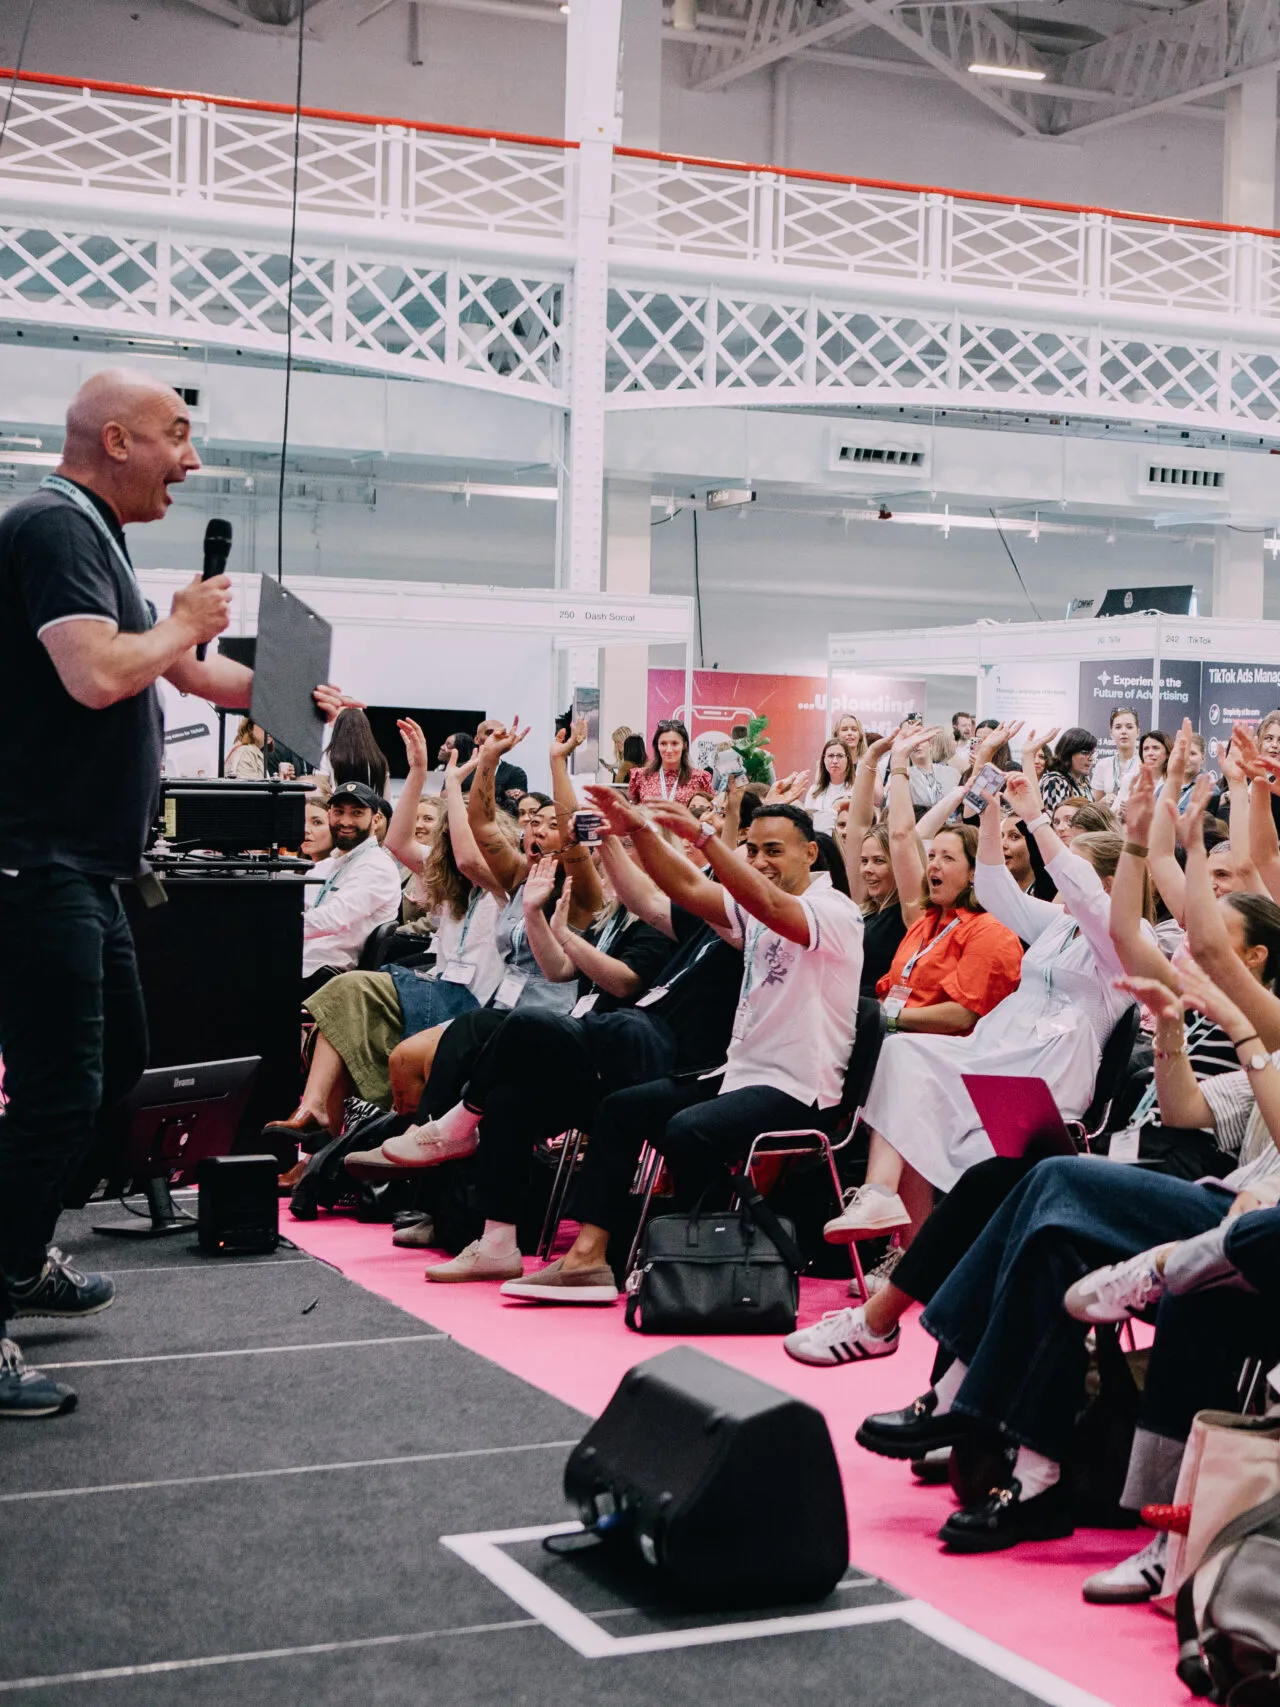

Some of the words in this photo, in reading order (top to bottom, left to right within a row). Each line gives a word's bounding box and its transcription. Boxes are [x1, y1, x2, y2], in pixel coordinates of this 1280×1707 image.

[559, 610, 575, 619] 250
[585, 611, 607, 621] Dash
[609, 612, 636, 622] Social
[1165, 634, 1180, 643] 242
[1188, 635, 1211, 645] TikTok
[1113, 674, 1164, 688] Experiene
[1166, 677, 1182, 688] the
[1208, 668, 1237, 684] TikTok
[1236, 669, 1253, 684] Ads
[1093, 687, 1123, 698] Future
[1125, 688, 1135, 699] of
[1135, 688, 1189, 703] Advrtising
